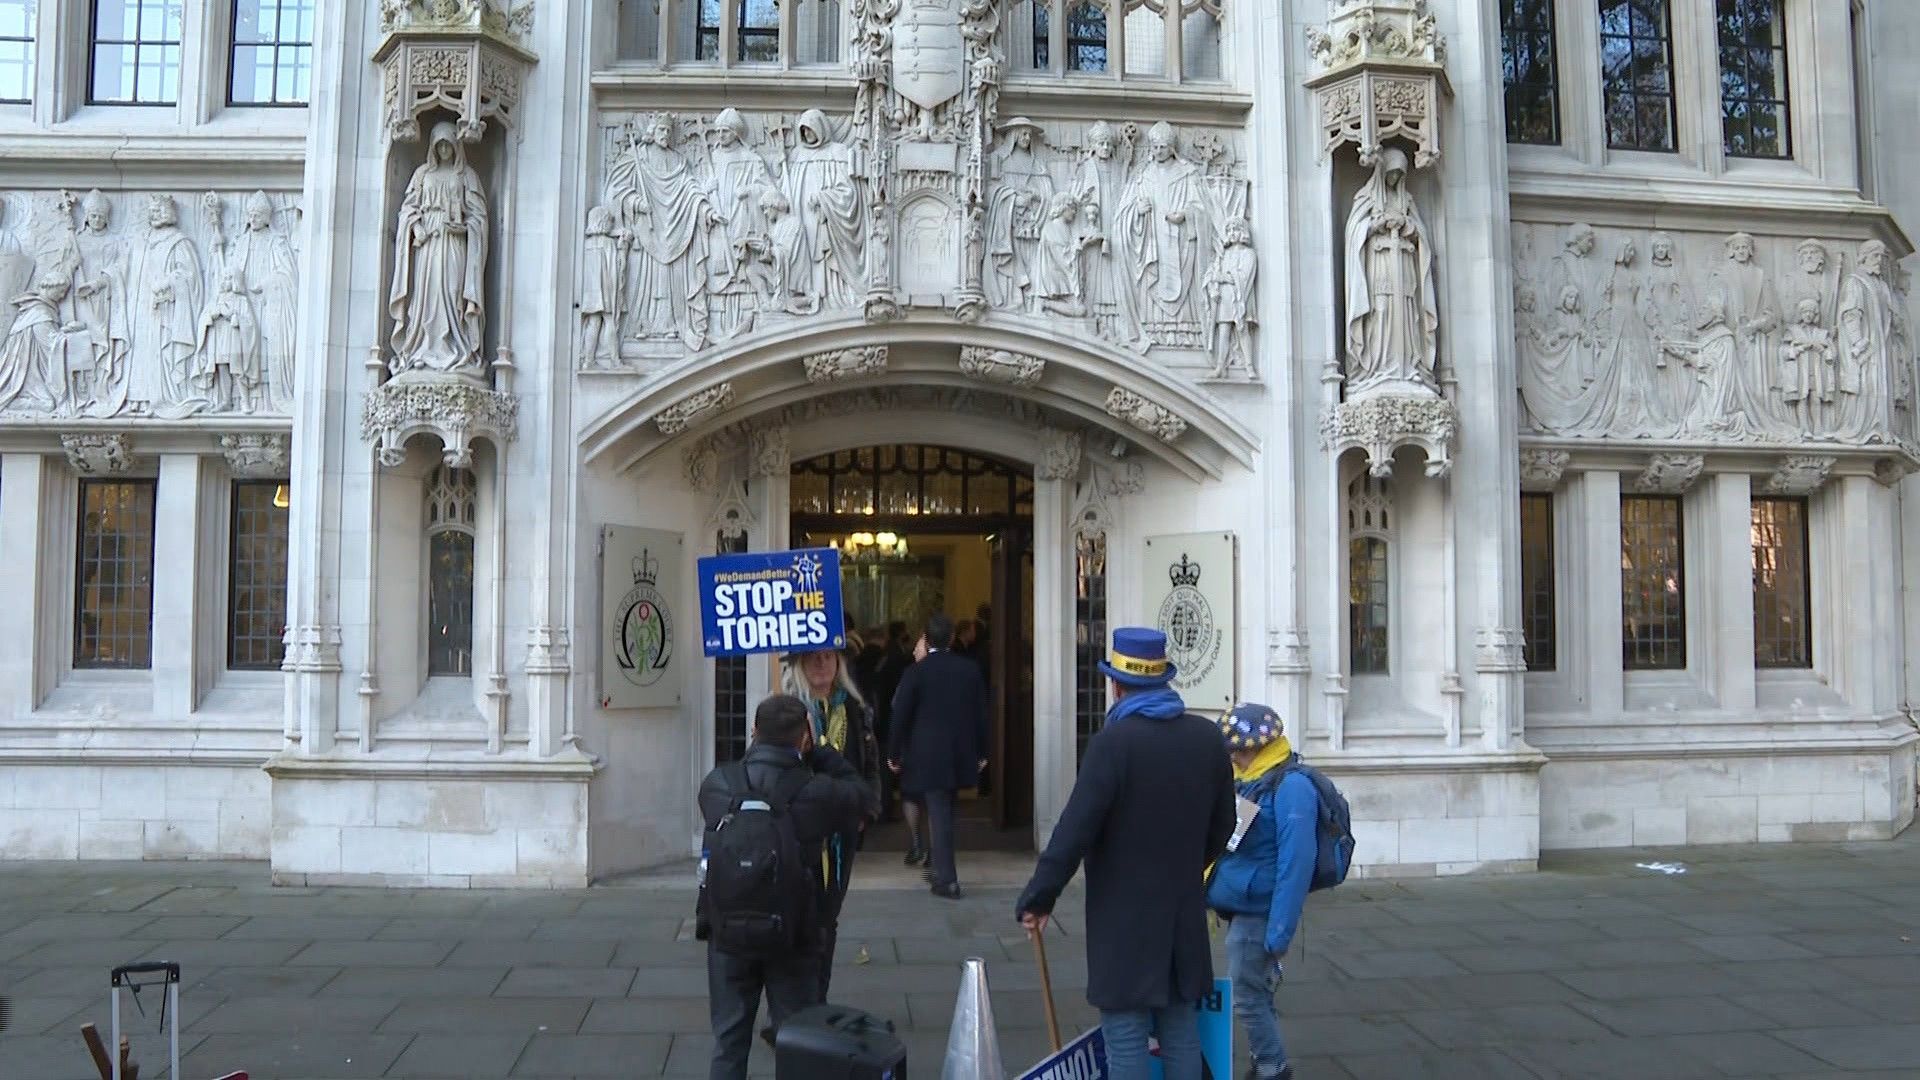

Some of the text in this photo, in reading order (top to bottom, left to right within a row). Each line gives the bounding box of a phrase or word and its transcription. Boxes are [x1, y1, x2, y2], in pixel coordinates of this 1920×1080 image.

[714, 569, 791, 583] #WeDemandBetter
[715, 580, 825, 617] STOP THE
[717, 611, 828, 650] TORIES
